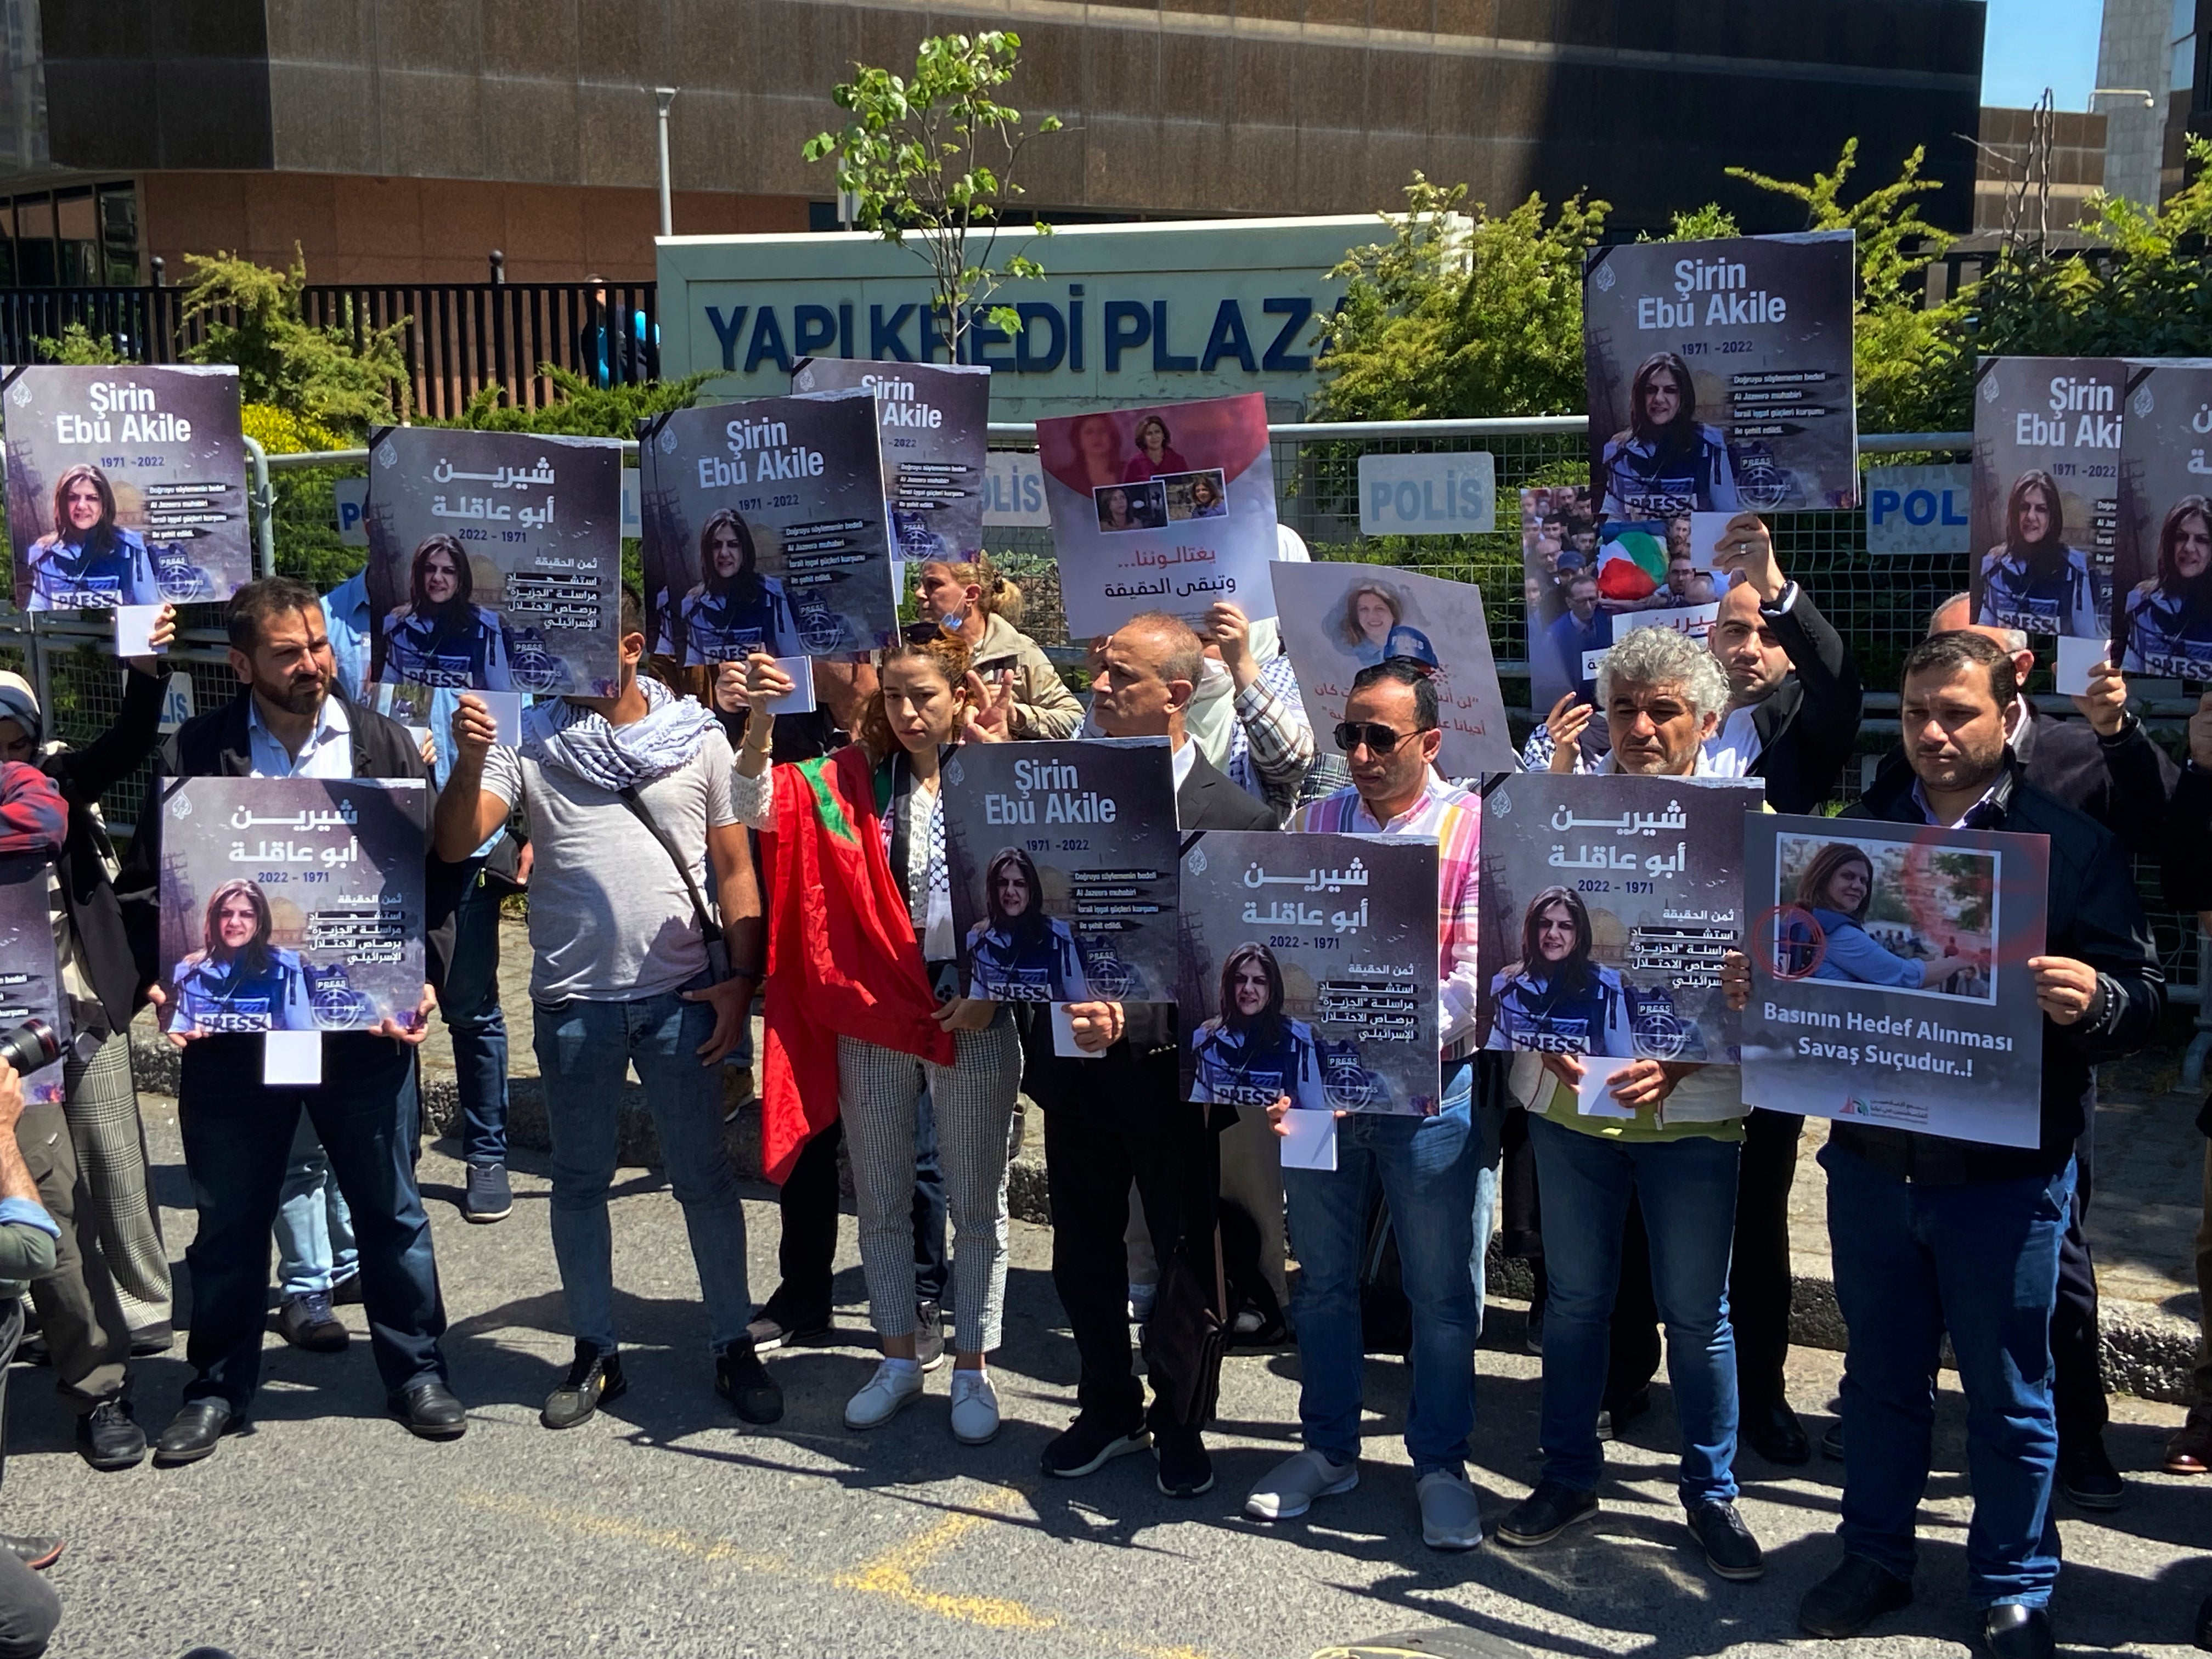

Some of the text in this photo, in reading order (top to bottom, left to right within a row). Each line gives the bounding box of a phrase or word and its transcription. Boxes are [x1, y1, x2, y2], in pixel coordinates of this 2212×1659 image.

[1674, 257, 1746, 301] Şirin
[1705, 290, 1786, 326] Akile
[704, 304, 854, 372] YAPI
[870, 284, 1085, 372] KREDİ
[1681, 343, 1708, 356] 1971
[90, 382, 155, 419] Şirin
[2050, 376, 2113, 419] Şirin
[120, 414, 191, 442] Akile
[882, 404, 941, 428] Akile
[726, 416, 788, 460] Şirin
[2074, 415, 2123, 450] Aki
[100, 457, 125, 468] 1971
[757, 446, 824, 482] Akile
[2053, 463, 2076, 476] 1971
[981, 466, 1042, 512] LİS
[1371, 469, 1483, 521] POLİS
[431, 495, 555, 529] أبو عاقلة
[739, 498, 762, 511] 1971
[1872, 489, 1968, 526] POL
[459, 528, 527, 543] 2022 1971
[534, 556, 597, 569] ثمن الحقيقة
[1105, 574, 1236, 600] وتبقى الحقيقة
[1014, 758, 1079, 799] Şirin
[1045, 791, 1116, 823] Akile
[229, 836, 358, 868] أبو عاقلة
[1026, 839, 1050, 851] 1971
[1548, 842, 1686, 878] أبو عاقلة
[257, 872, 329, 883] 2022 1971
[1577, 879, 1654, 894] 2022 1971
[337, 892, 402, 906] ثمن الحقيقة
[1242, 898, 1368, 934] أبو عاقلة
[1662, 909, 1734, 922] ثمن الحقيقة
[1269, 935, 1339, 949] 2022 1971
[1686, 945, 1728, 958] راسلة
[1348, 963, 1414, 977] ثمن الحقيقة
[1685, 961, 1726, 973] صاص
[1764, 1002, 2012, 1051] Basının Hedef Alınması
[1798, 1037, 1859, 1066] Savaş
